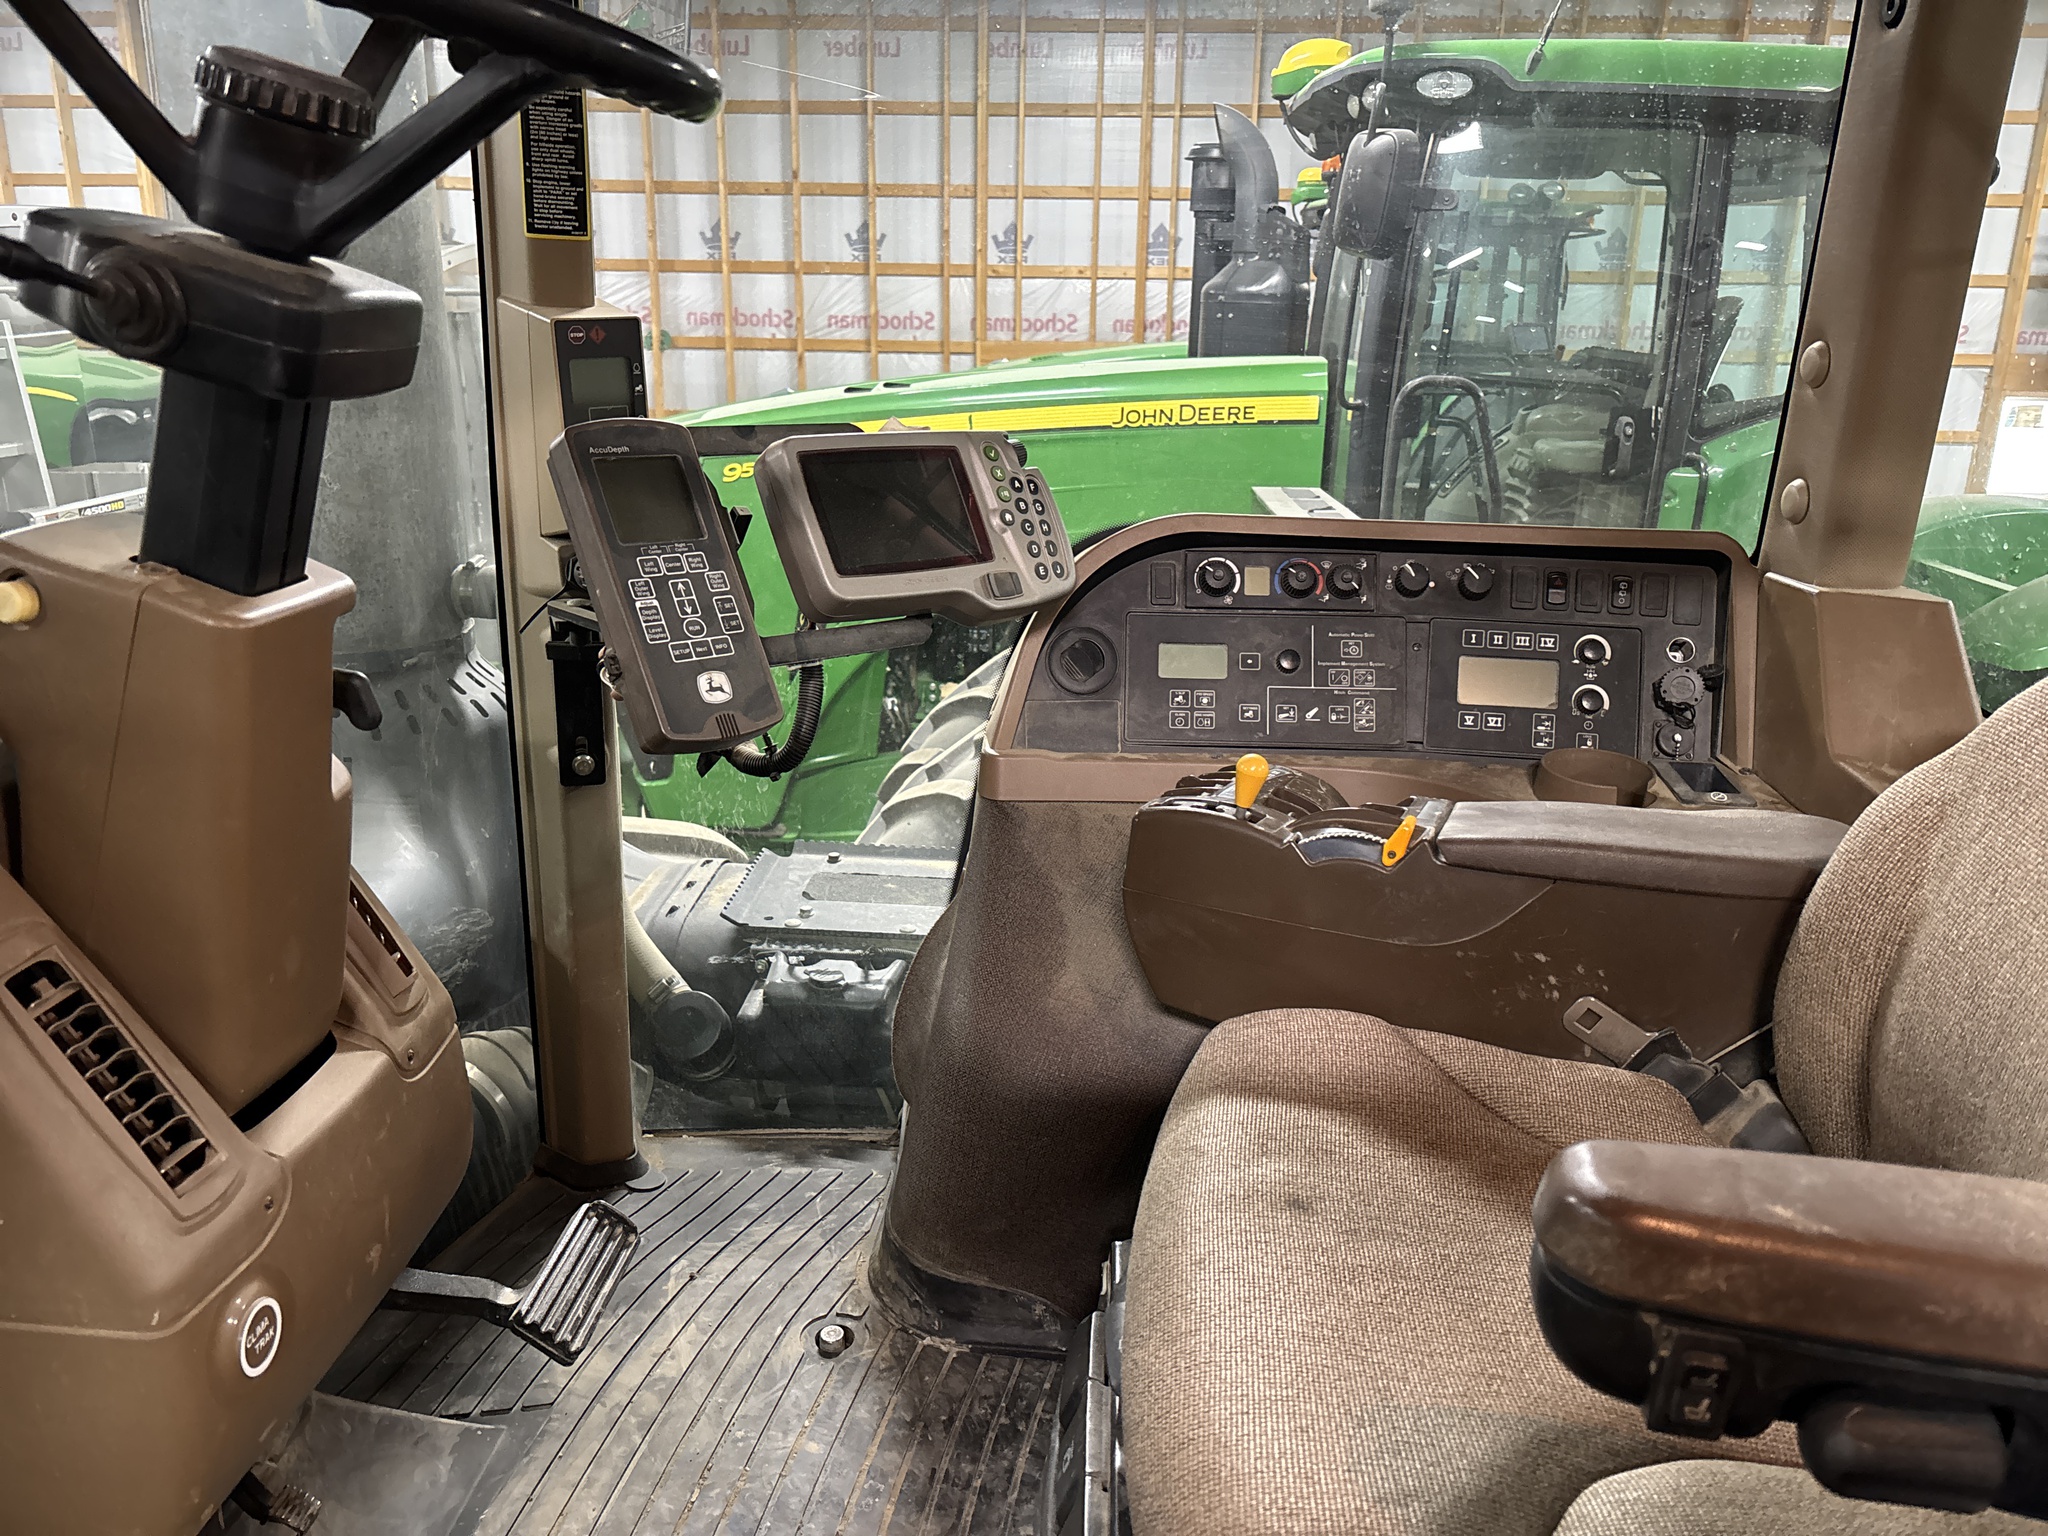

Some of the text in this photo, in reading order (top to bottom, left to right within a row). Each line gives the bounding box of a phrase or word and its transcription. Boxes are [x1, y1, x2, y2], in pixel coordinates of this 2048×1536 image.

[1112, 404, 1256, 424] JOHN DEERE
[589, 446, 630, 454] AccuDepth
[1014, 480, 1020, 488] A
[1025, 523, 1031, 531] C
[1042, 523, 1048, 531] H
[1032, 545, 1038, 553] D
[1040, 566, 1045, 575] E
[1056, 565, 1061, 574] J
[1470, 634, 1476, 643] I
[1493, 635, 1503, 644] II
[1516, 636, 1530, 646] III
[1540, 638, 1555, 647] IV
[1464, 715, 1474, 725] V
[1487, 717, 1502, 726] VI
[247, 1316, 270, 1348] CLIMA
[254, 1326, 274, 1354] TRAK
